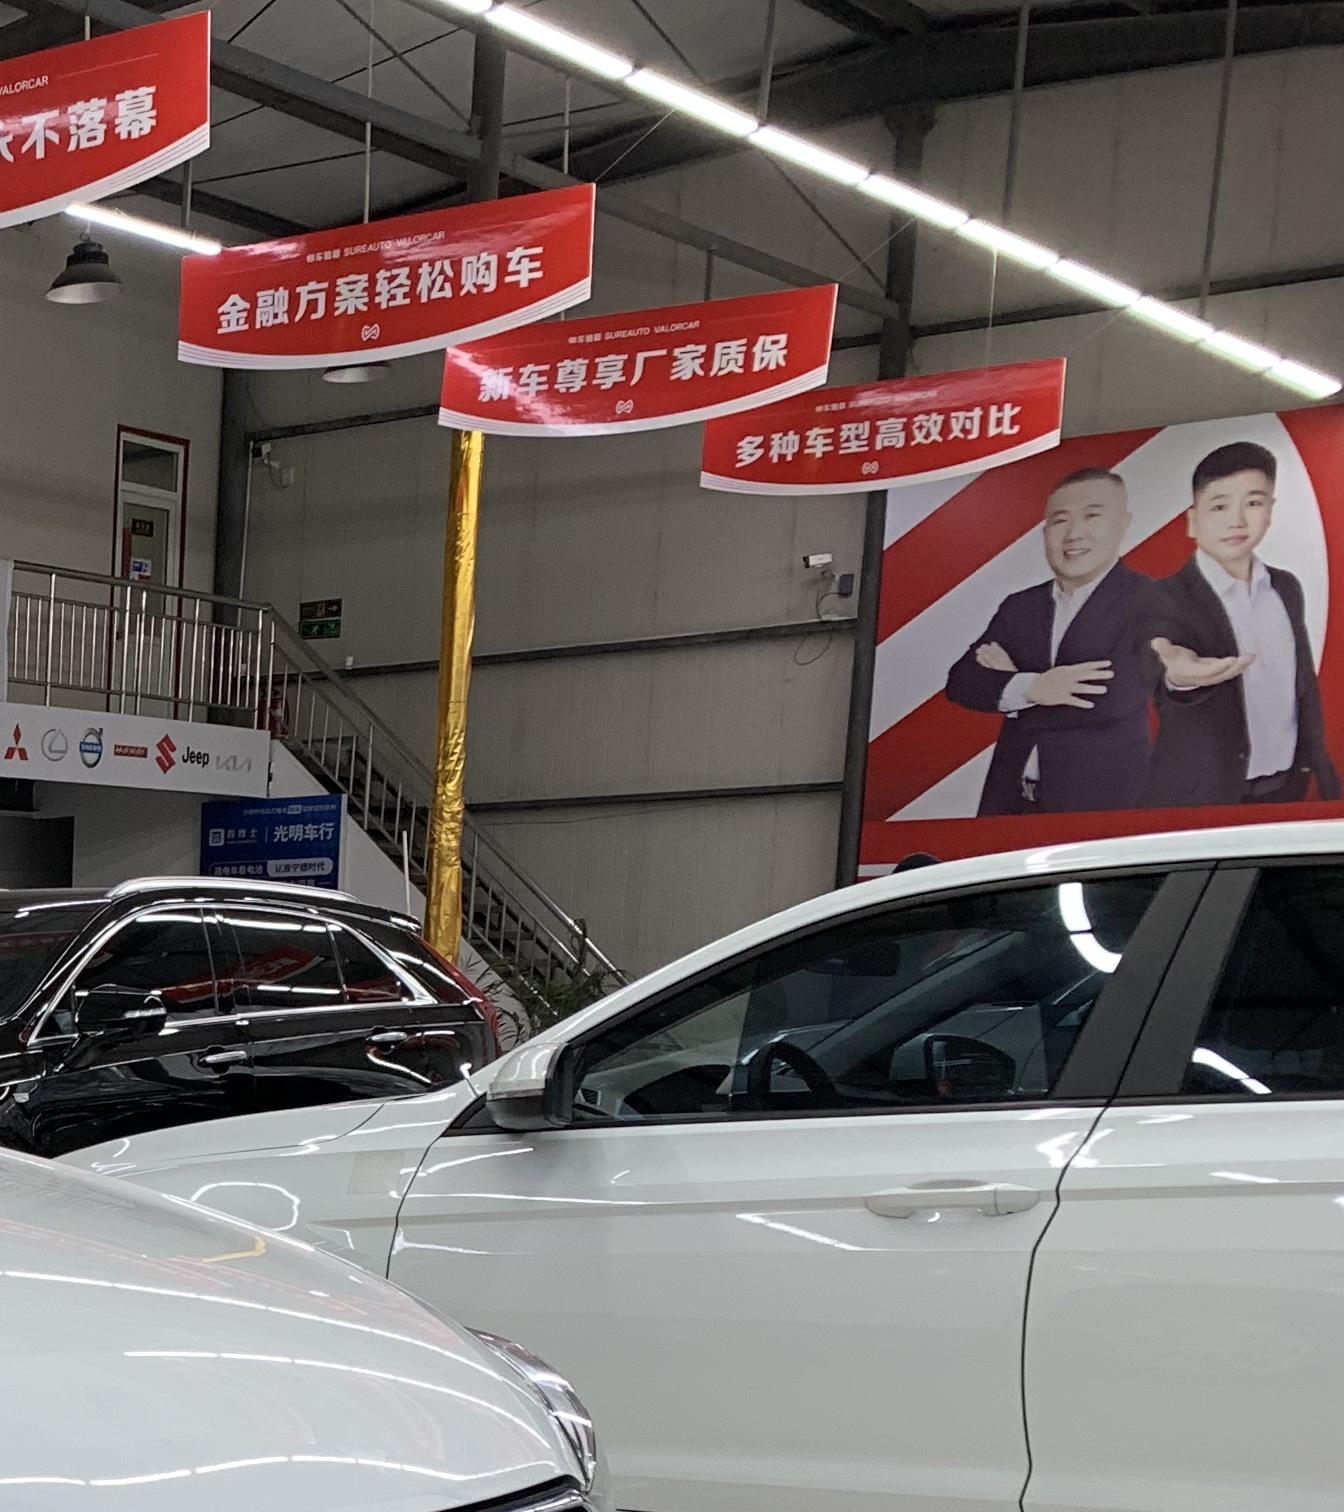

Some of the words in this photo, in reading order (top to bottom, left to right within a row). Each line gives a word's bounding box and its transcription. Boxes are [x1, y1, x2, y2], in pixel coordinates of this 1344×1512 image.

[343, 242, 392, 258] SUREAUTO
[395, 230, 445, 248] VALORCAR
[217, 246, 544, 335] 金融方案轻松购车
[604, 326, 650, 341] SUREAUTO
[654, 320, 700, 334] VALORCAR
[478, 333, 788, 402] 新车尊享厂家质保
[735, 403, 1022, 468] 多种车型高效对比
[181, 746, 210, 767] Jeep
[273, 822, 334, 843] 光明车行
